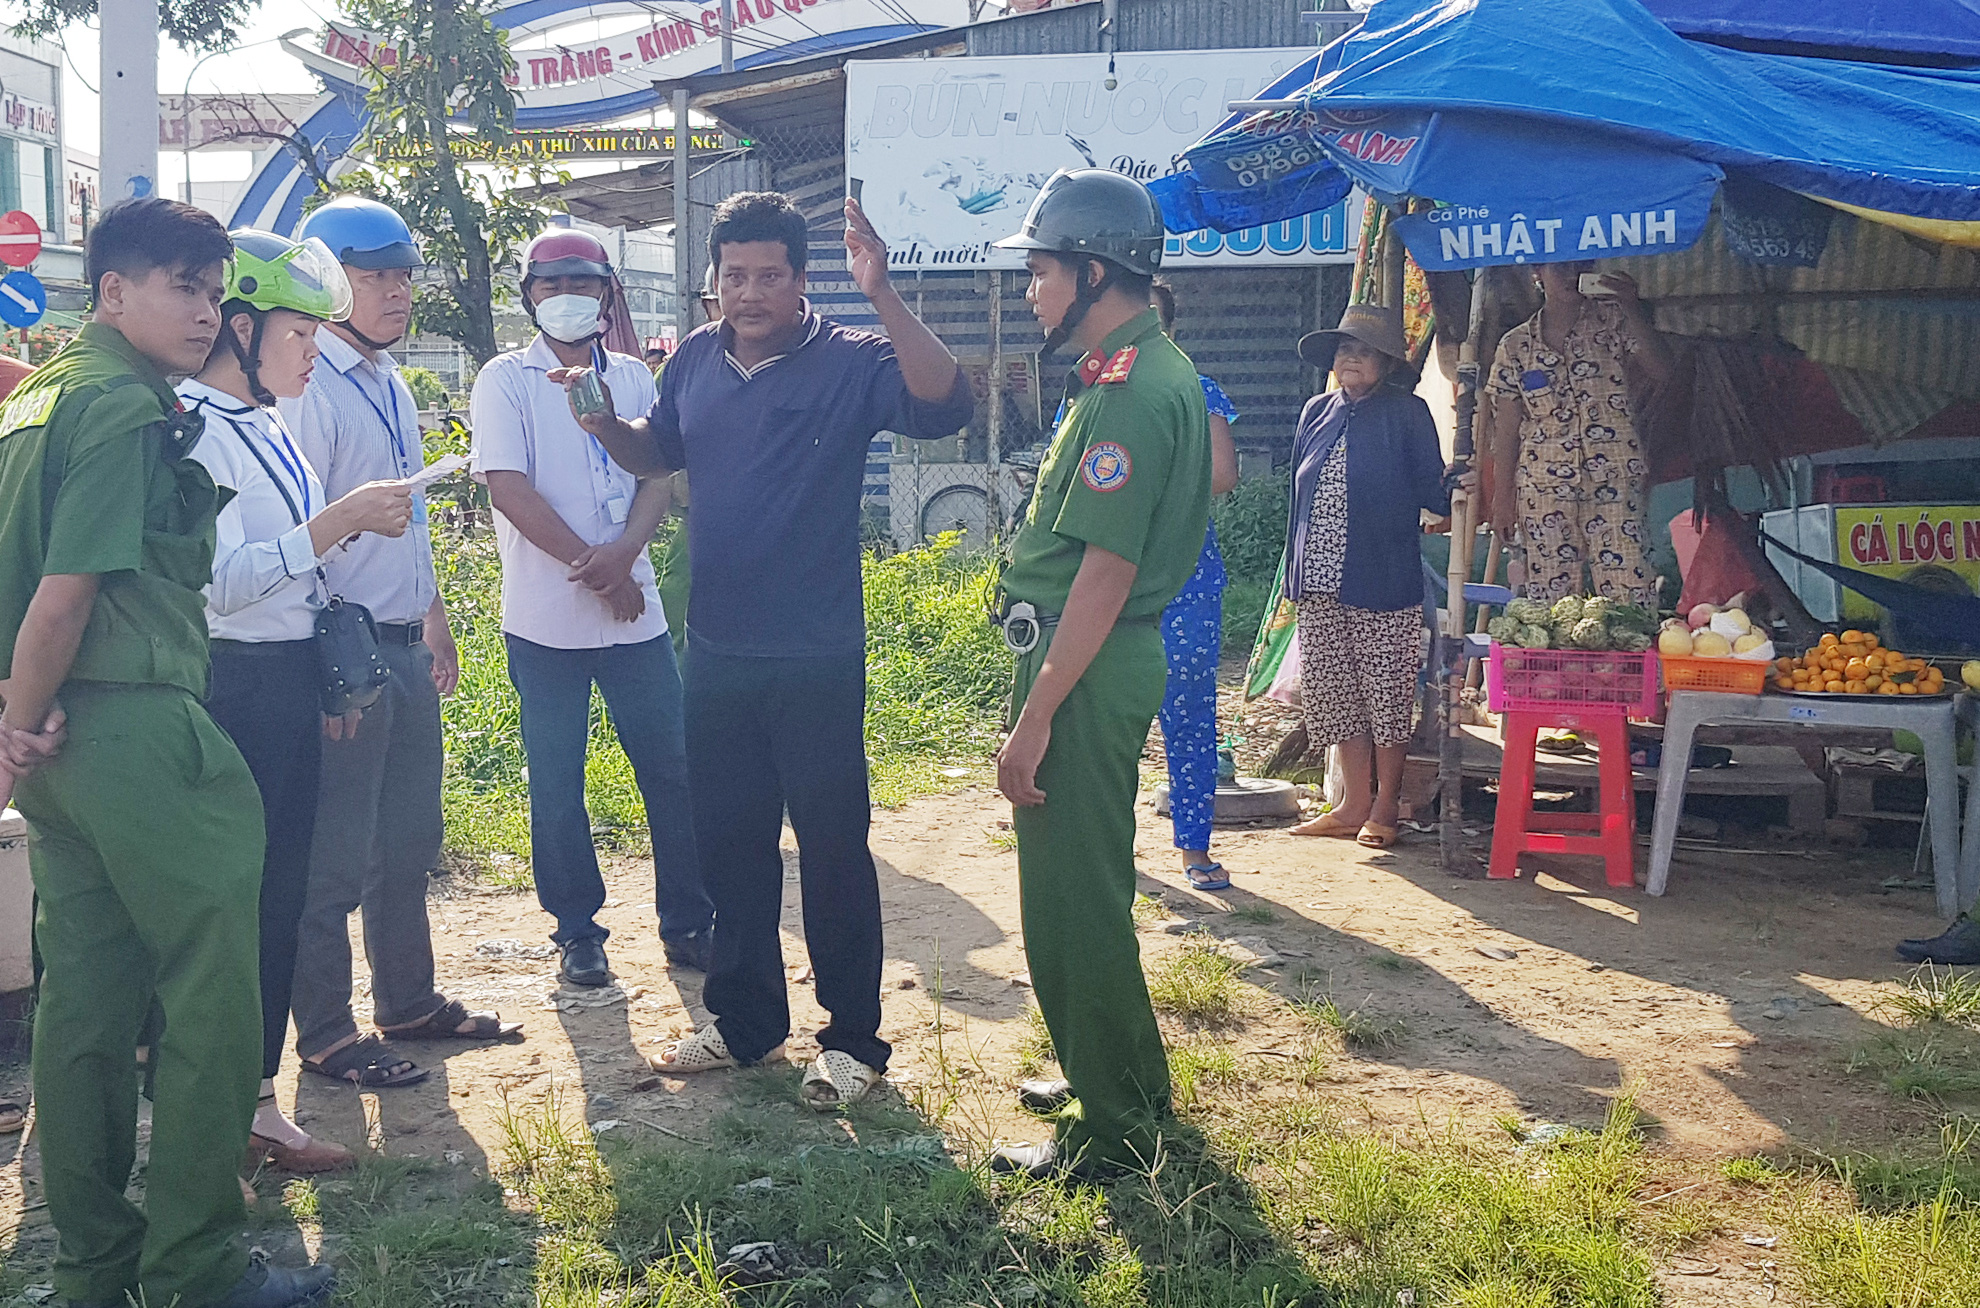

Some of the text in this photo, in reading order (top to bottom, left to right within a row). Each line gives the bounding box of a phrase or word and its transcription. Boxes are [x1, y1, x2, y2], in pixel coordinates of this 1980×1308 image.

[636, 19, 697, 63] KÍNH
[582, 135, 617, 152] XIII
[621, 131, 660, 152] CỦA
[663, 134, 724, 152] ĐNG!
[1458, 202, 1491, 221] Phê
[885, 241, 991, 265] ính mời!
[1439, 212, 1563, 264] NHẬT
[1577, 208, 1677, 251] ANH
[1849, 512, 1892, 566] CÁ
